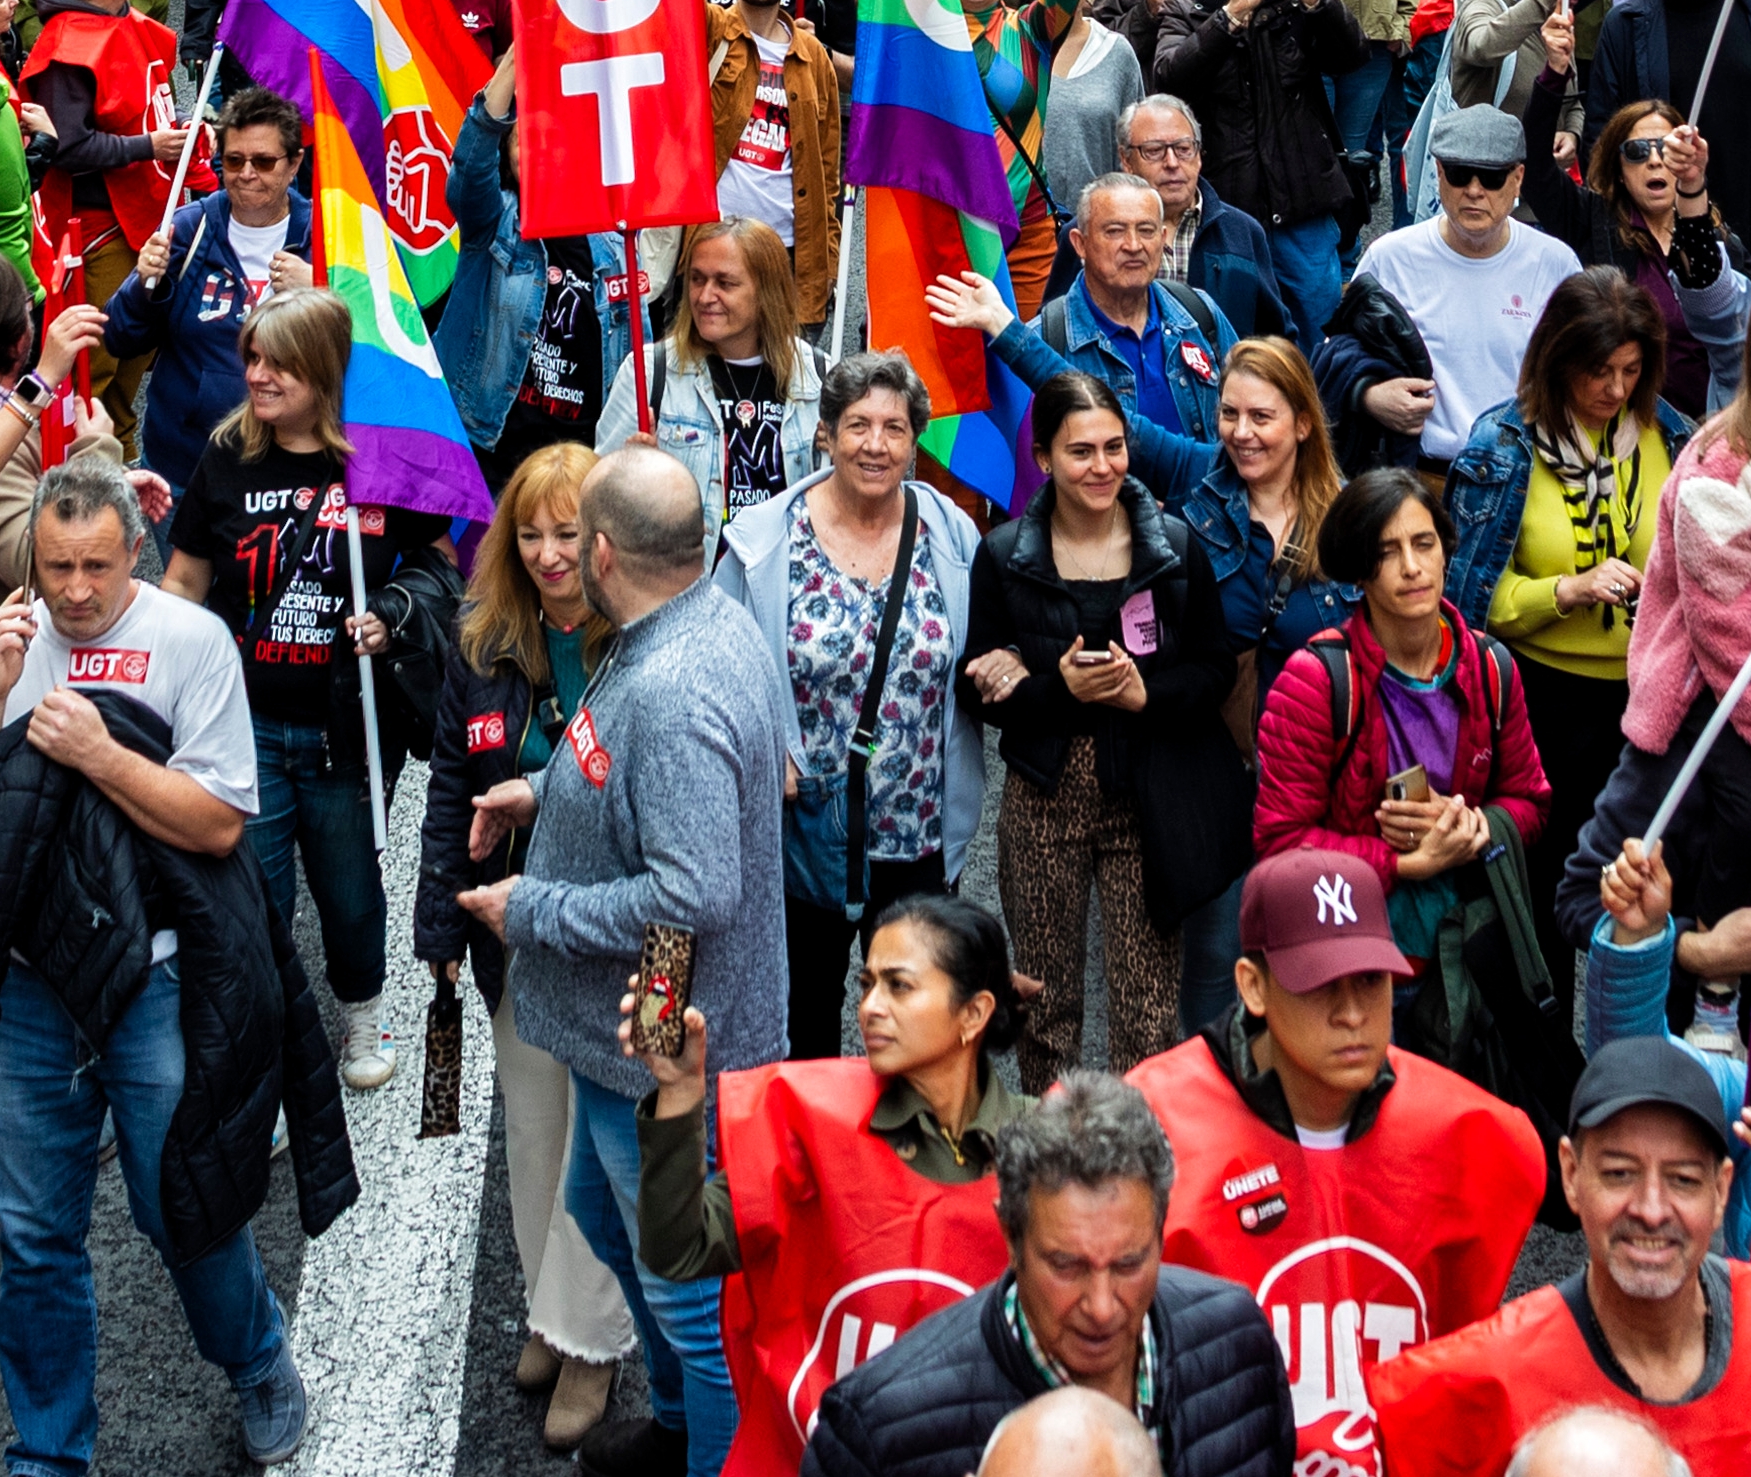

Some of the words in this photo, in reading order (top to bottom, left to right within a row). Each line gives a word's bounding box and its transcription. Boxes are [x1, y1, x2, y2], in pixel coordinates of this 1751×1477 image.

[739, 148, 757, 161] UGT
[535, 365, 560, 385] UTURO
[543, 383, 585, 404] DERECHOS
[245, 489, 292, 515] UGT
[729, 489, 771, 506] PASADO
[287, 580, 323, 594] SADO
[277, 593, 330, 611] RESENTE
[331, 596, 344, 612] Y
[271, 608, 317, 627] FUTURO
[270, 624, 294, 642] TUS
[295, 627, 336, 644] DEREC
[254, 639, 330, 663] DEFIEND
[68, 652, 122, 679] UGT
[570, 711, 594, 763] UGT
[1313, 873, 1358, 926] NY
[1222, 1164, 1280, 1202] ÚNETE
